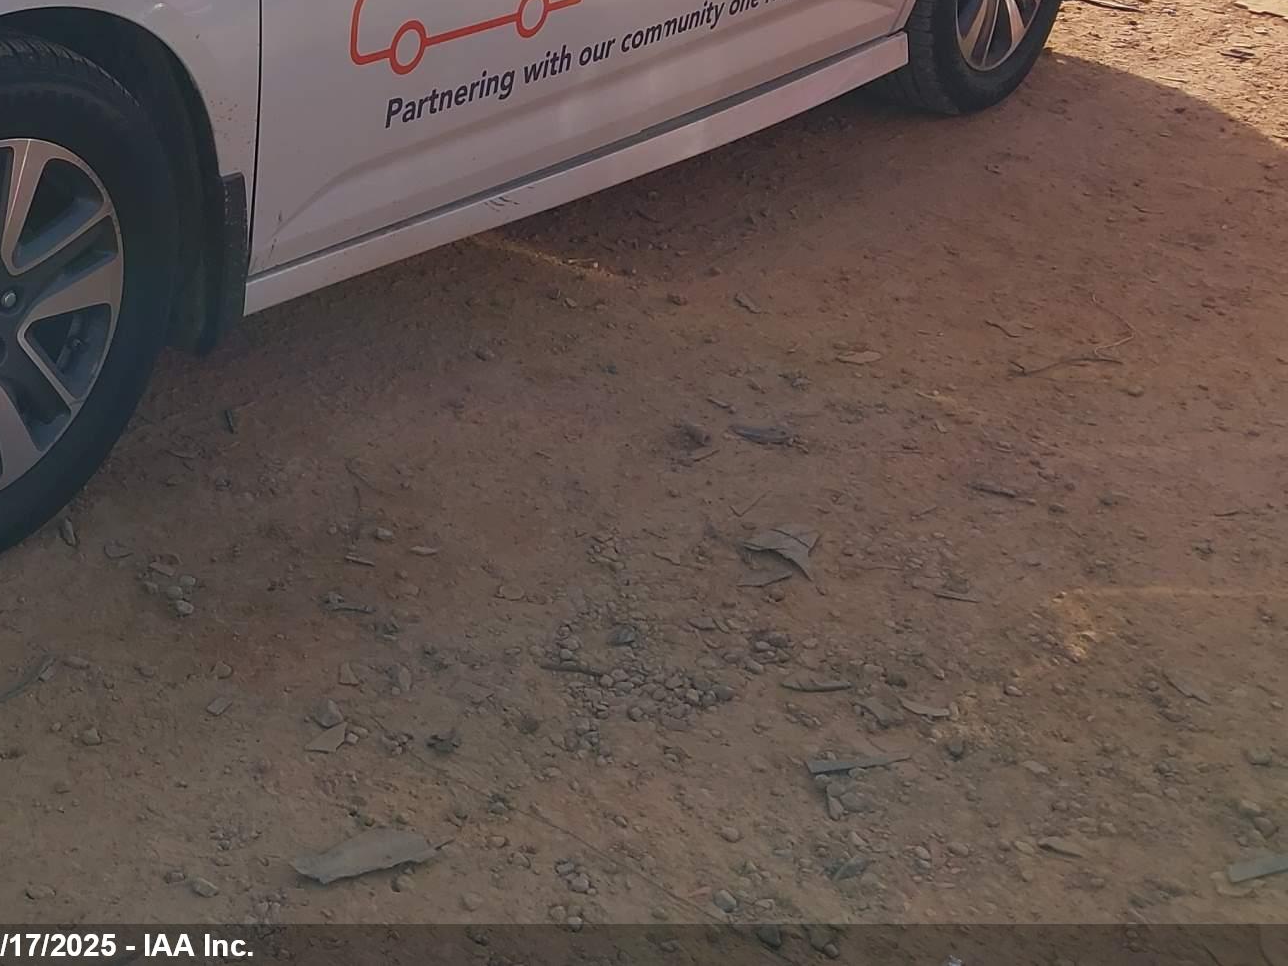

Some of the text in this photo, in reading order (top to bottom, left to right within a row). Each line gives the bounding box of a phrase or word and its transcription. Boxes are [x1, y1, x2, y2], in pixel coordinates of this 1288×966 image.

[384, 67, 515, 129] Partnering
[523, 45, 573, 86] with
[579, 36, 616, 65] our
[621, 0, 725, 55] community
